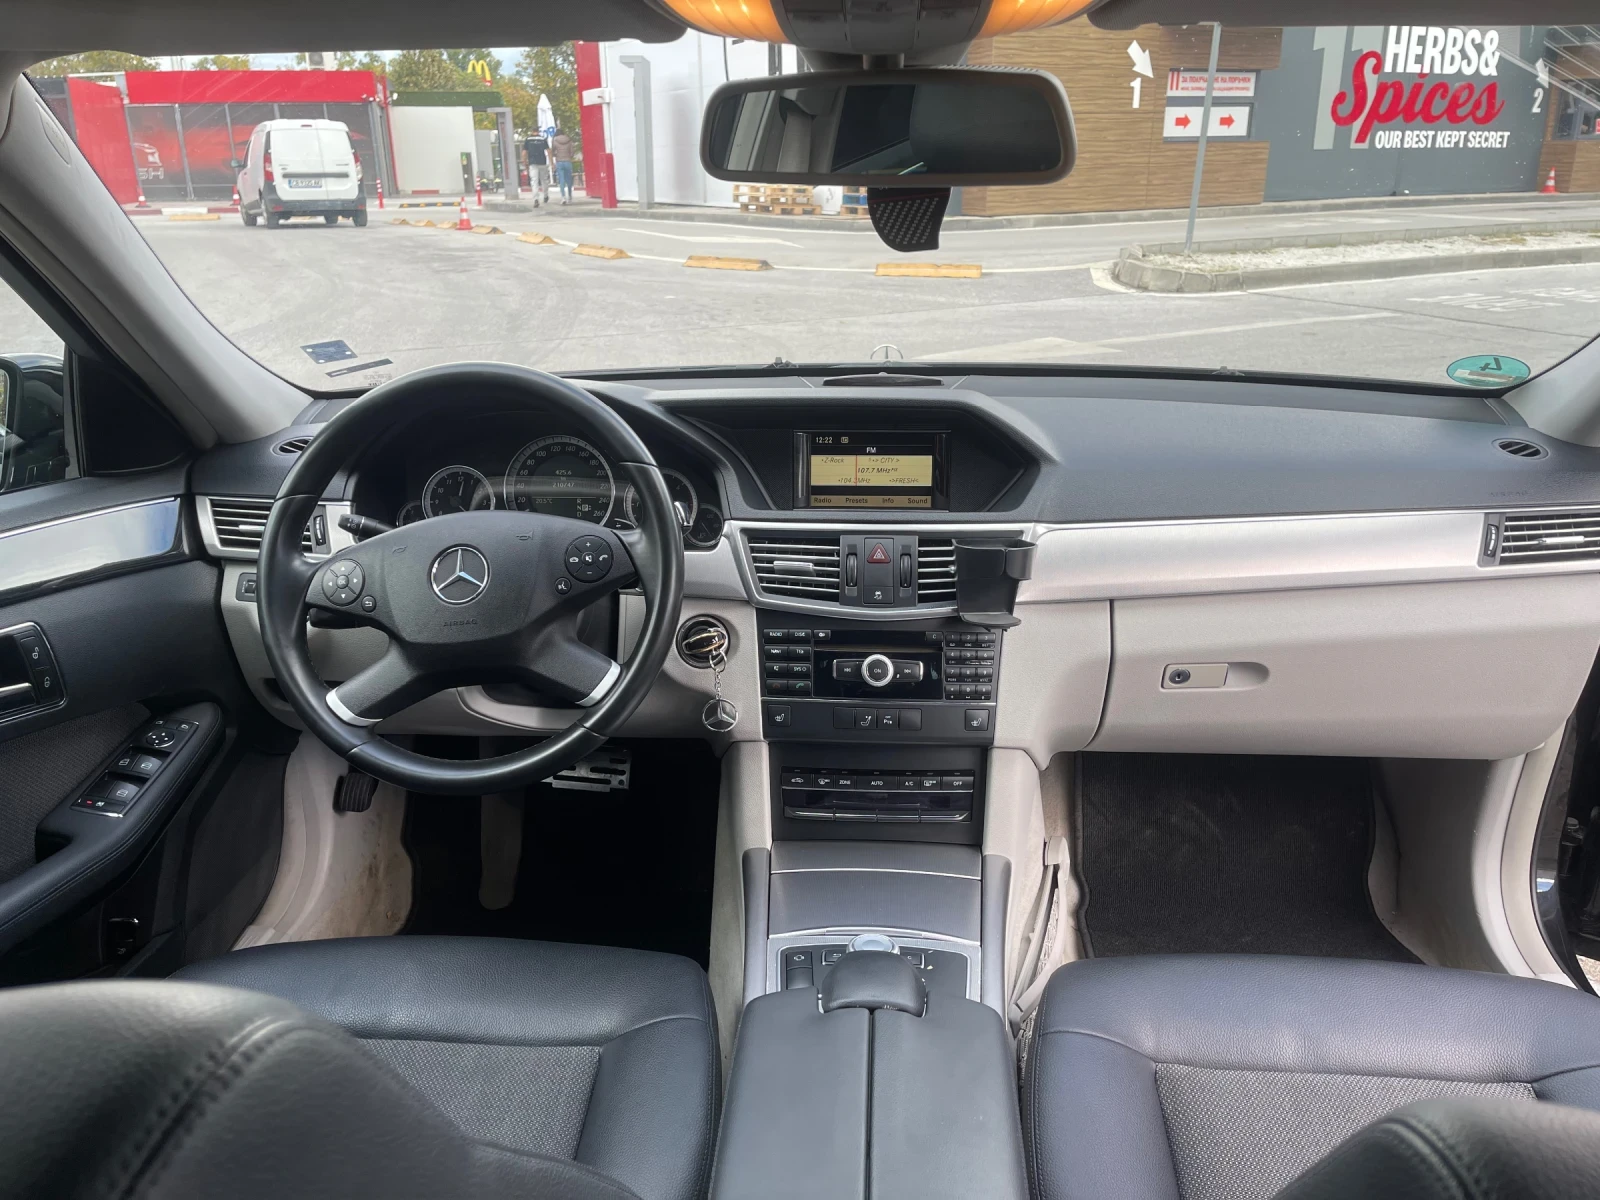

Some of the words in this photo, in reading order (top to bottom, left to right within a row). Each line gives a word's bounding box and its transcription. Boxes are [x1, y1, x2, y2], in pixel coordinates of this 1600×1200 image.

[1129, 77, 1142, 109] 1
[1330, 50, 1505, 144] Spices
[1531, 87, 1544, 113] 2
[1375, 131, 1403, 149] OUR
[1403, 131, 1436, 149] BEST
[1436, 131, 1468, 149] KEPT
[1467, 131, 1511, 149] SECRET
[815, 436, 833, 444] 12:22
